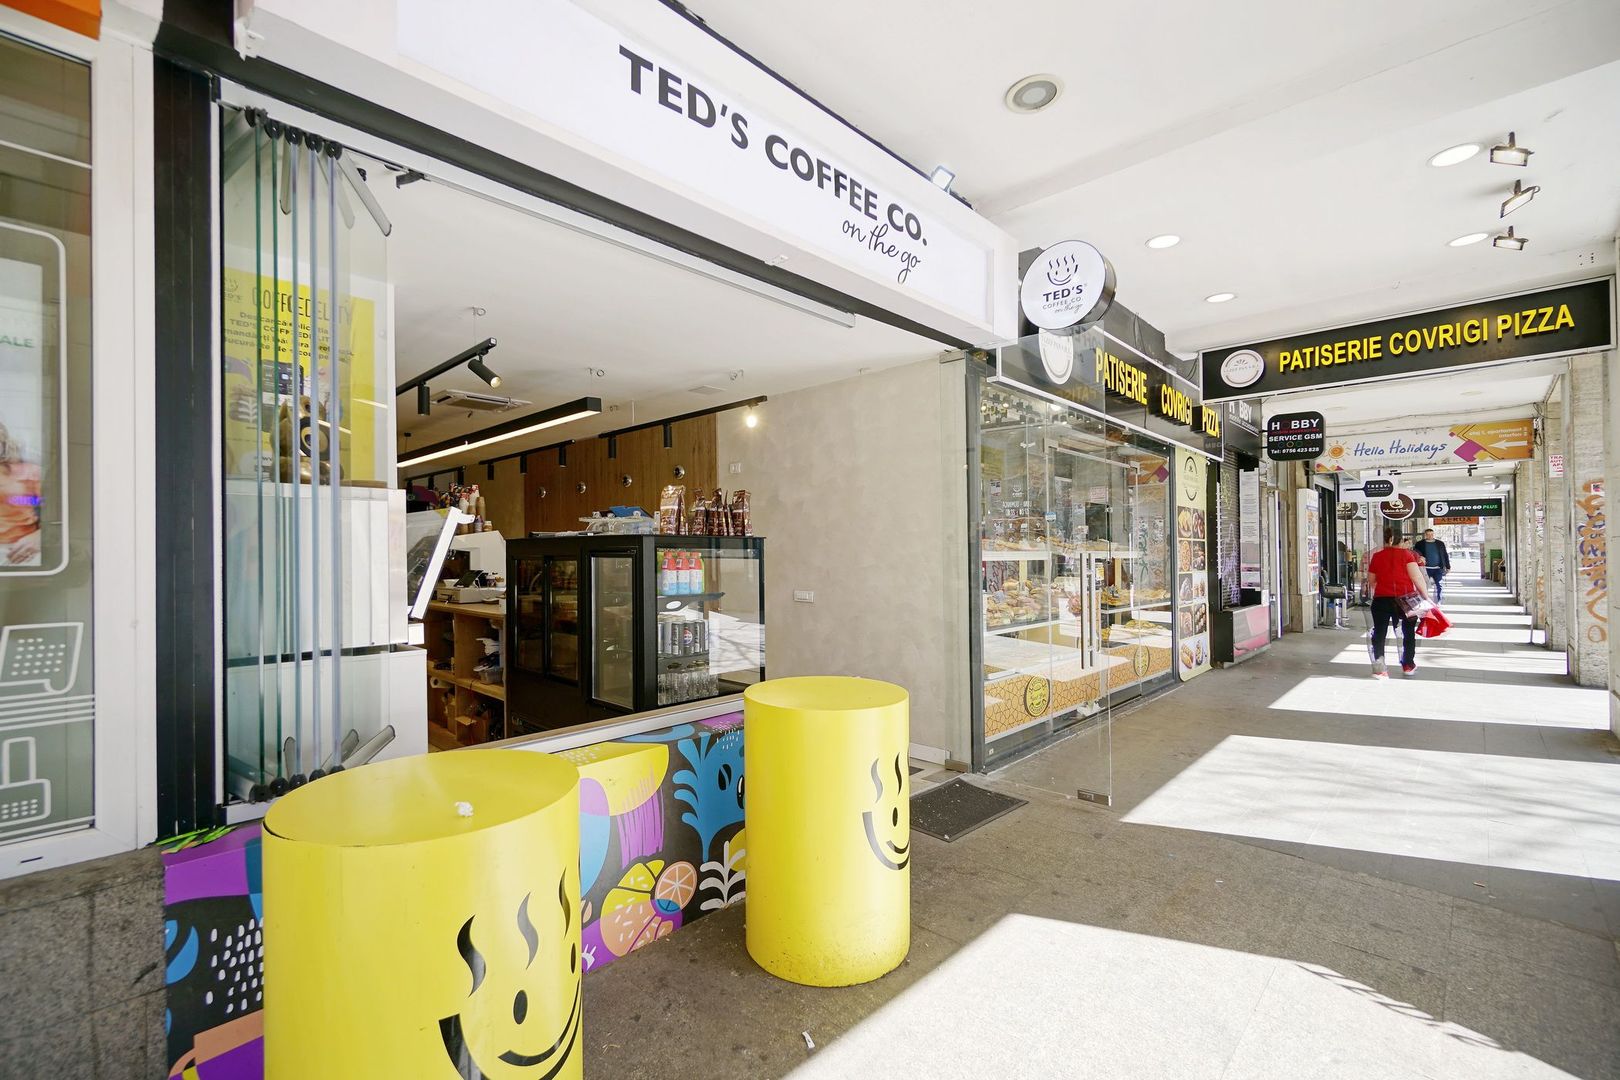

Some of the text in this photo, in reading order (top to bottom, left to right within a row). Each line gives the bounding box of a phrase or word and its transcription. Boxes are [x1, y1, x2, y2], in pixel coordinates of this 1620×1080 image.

[619, 44, 929, 247] TED'S COFFEE CO.
[842, 219, 921, 285] on the go
[1042, 284, 1083, 302] TED'S
[1042, 299, 1070, 310] COFFEE
[1277, 303, 1576, 373] PATISERIE COVRIGI PIZZA
[1095, 346, 1149, 405] PATISERIE
[1161, 383, 1193, 426] COVRIGI
[1202, 404, 1220, 438] PIZZA
[1269, 434, 1303, 442] SERVICE
[1354, 442, 1385, 457] Hello
[1389, 439, 1448, 460] Holidays
[1435, 503, 1443, 513] 5
